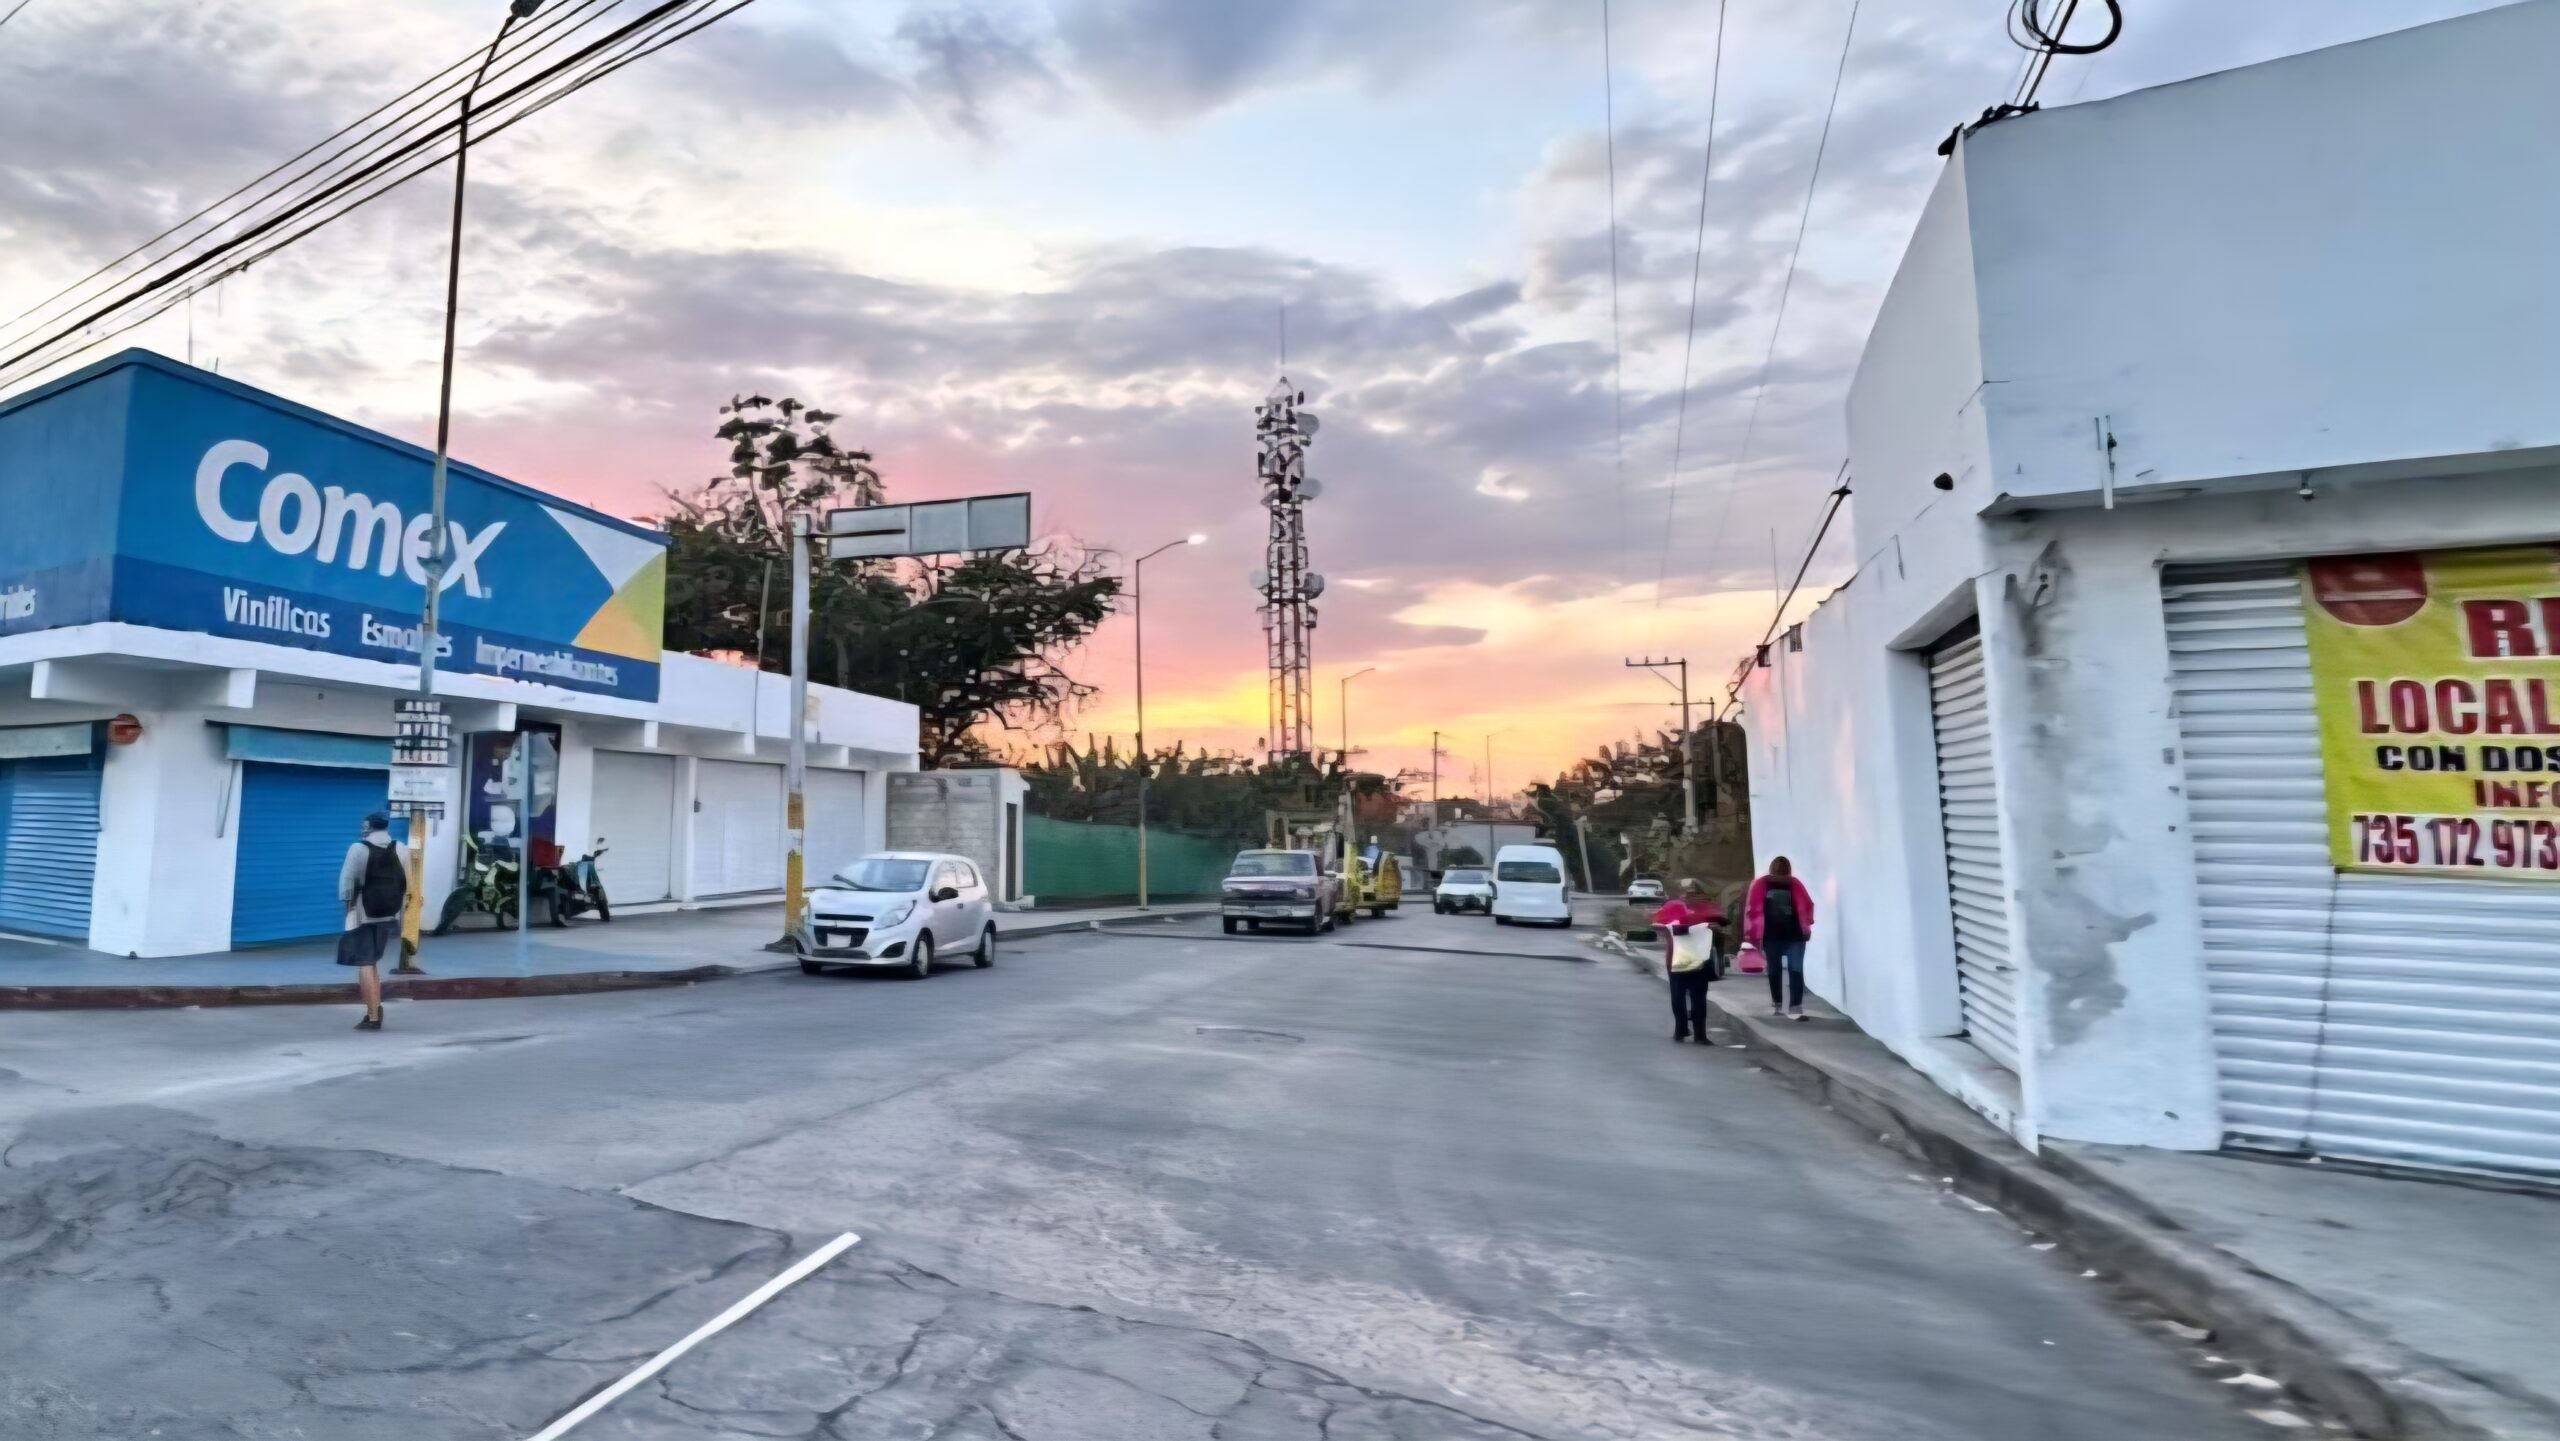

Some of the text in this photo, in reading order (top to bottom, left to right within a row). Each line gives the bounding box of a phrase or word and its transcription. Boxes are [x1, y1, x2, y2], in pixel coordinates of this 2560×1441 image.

[194, 438, 507, 599] Comex
[361, 612, 454, 658] Esmals
[2357, 678, 2560, 734] LOCAL
[2376, 745, 2466, 772] CON
[2352, 814, 2420, 865] 735
